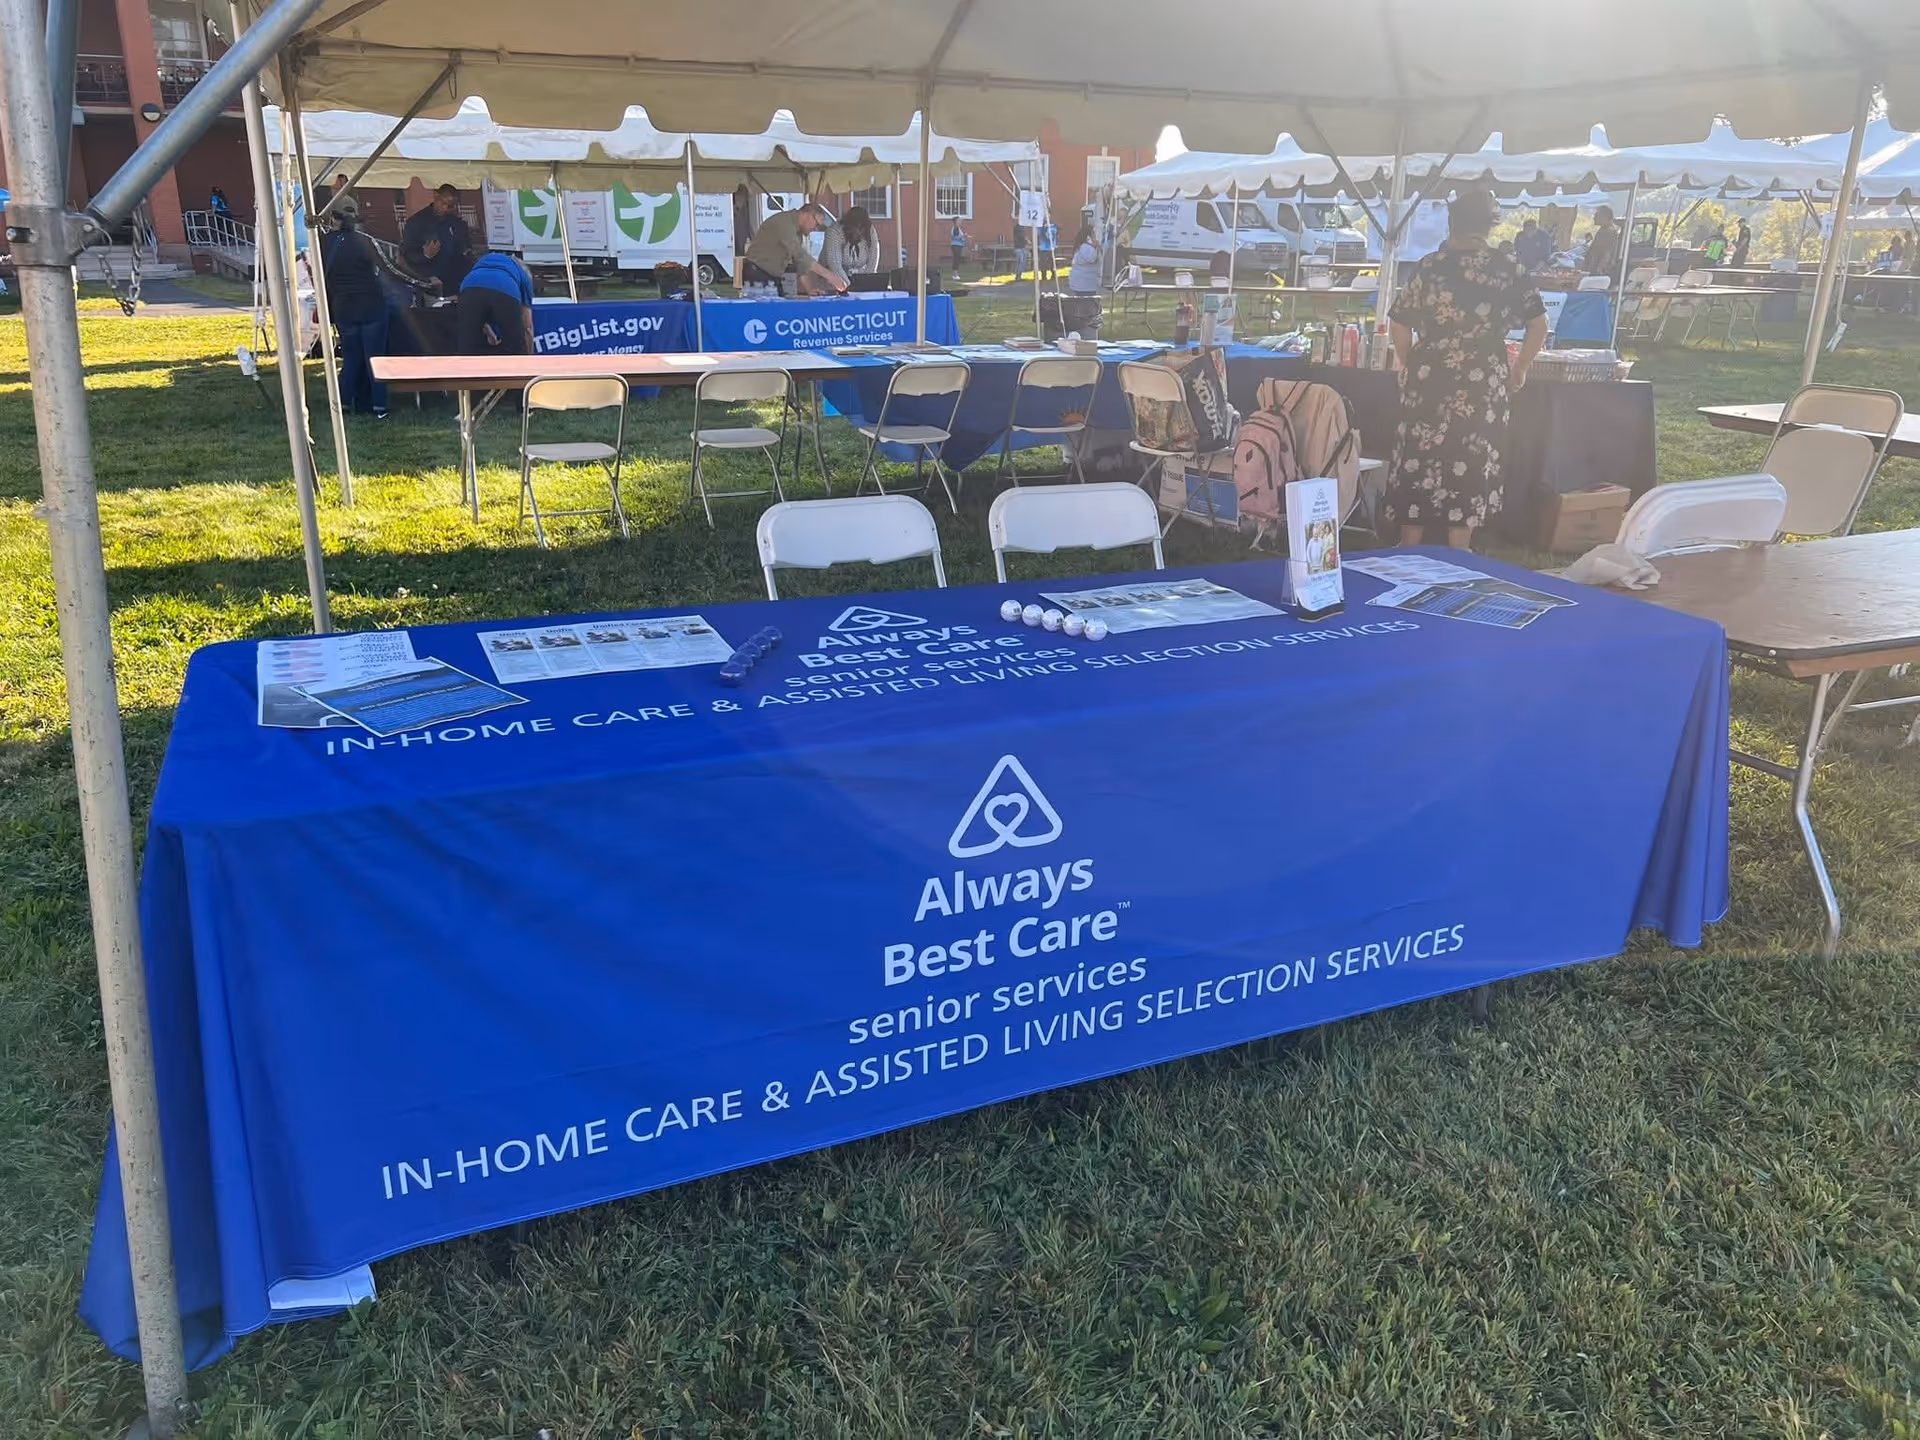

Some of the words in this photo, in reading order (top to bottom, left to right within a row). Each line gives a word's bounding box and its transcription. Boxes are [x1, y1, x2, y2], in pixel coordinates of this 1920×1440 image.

[1027, 209, 1038, 220] 12
[533, 316, 664, 353] TBigList.gov
[775, 310, 907, 336] CONNECTICUT
[793, 336, 844, 349] Revenue
[846, 331, 894, 344] Services
[817, 625, 978, 649] Always
[785, 664, 909, 688] senior
[923, 647, 1077, 673] services
[798, 647, 911, 668] Best
[327, 718, 555, 755] IN-HOME
[572, 704, 694, 726] CARE
[712, 699, 741, 712] &
[758, 677, 940, 708] ASSISTED
[950, 661, 1079, 685] LIVING
[1083, 638, 1271, 670] SELECTION
[1272, 620, 1421, 646] SERVICES
[914, 857, 1094, 922] Always
[884, 929, 995, 987] Best
[849, 992, 981, 1044] senior
[992, 956, 1147, 1012] services
[382, 1119, 609, 1200] IN-HOME
[625, 1090, 743, 1142] CARE
[761, 1081, 791, 1112] &
[804, 1033, 989, 1105] ASSISTED
[1004, 1000, 1124, 1056] LIVING
[1136, 957, 1315, 1024] SELECTION
[1326, 923, 1465, 980] SERVICES
